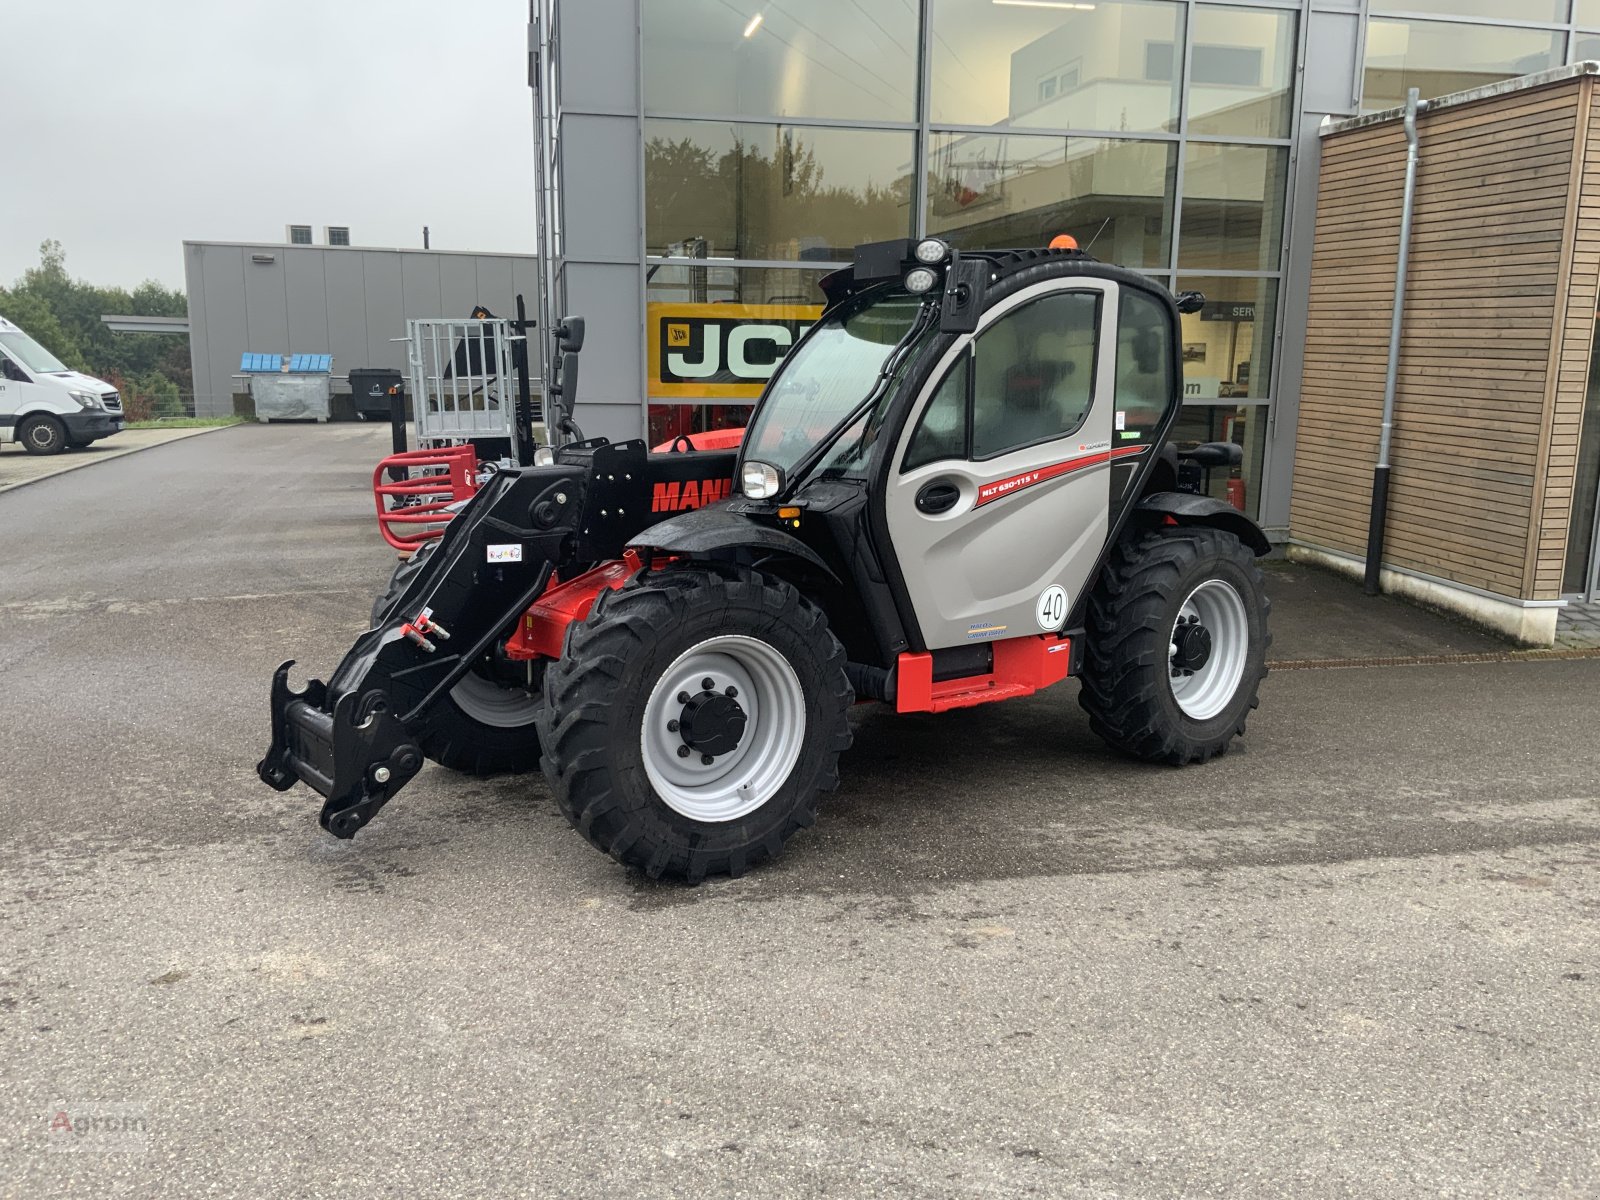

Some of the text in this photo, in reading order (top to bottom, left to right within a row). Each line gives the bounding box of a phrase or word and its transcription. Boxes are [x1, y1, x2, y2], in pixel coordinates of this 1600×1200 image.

[667, 324, 812, 378] JC
[998, 476, 1031, 492] 630-115
[1042, 593, 1063, 622] 40
